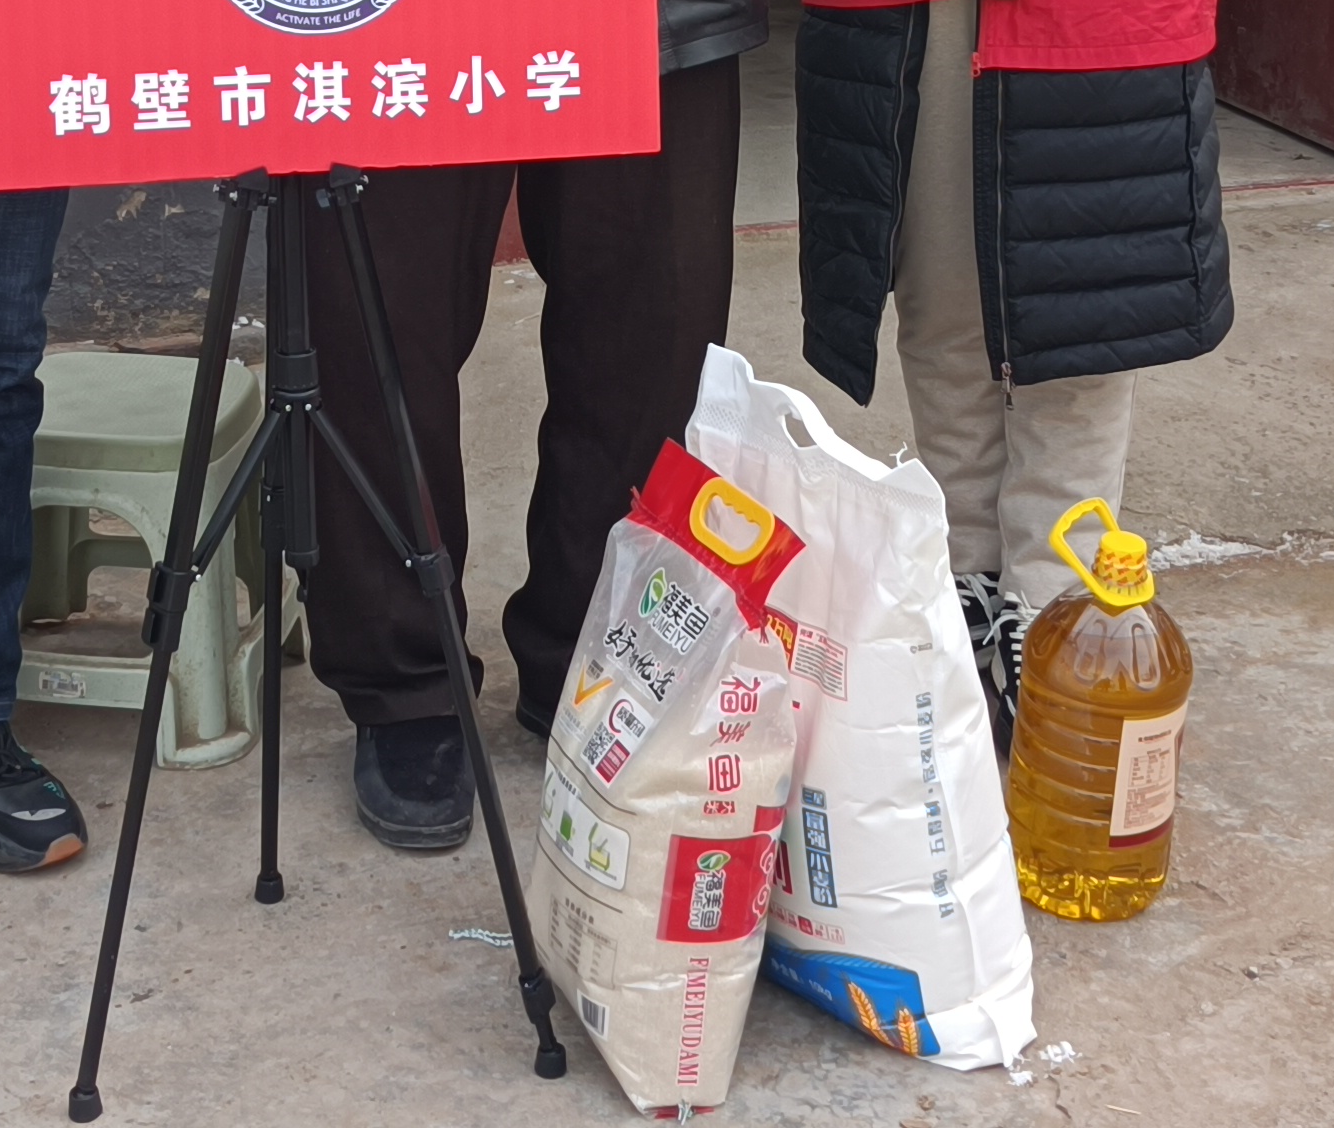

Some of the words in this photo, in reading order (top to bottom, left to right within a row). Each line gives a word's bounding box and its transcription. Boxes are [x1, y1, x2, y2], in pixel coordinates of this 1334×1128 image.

[275, 10, 322, 26] ACTIVATE
[323, 9, 342, 25] THE
[343, 8, 362, 22] LIFE
[48, 50, 582, 137] 鹤壁市淇滨小学
[651, 611, 694, 654] FUMEIYU
[663, 583, 710, 641] 福美鱼
[688, 873, 706, 930] FUMEIYU
[700, 870, 726, 930] 福美鱼
